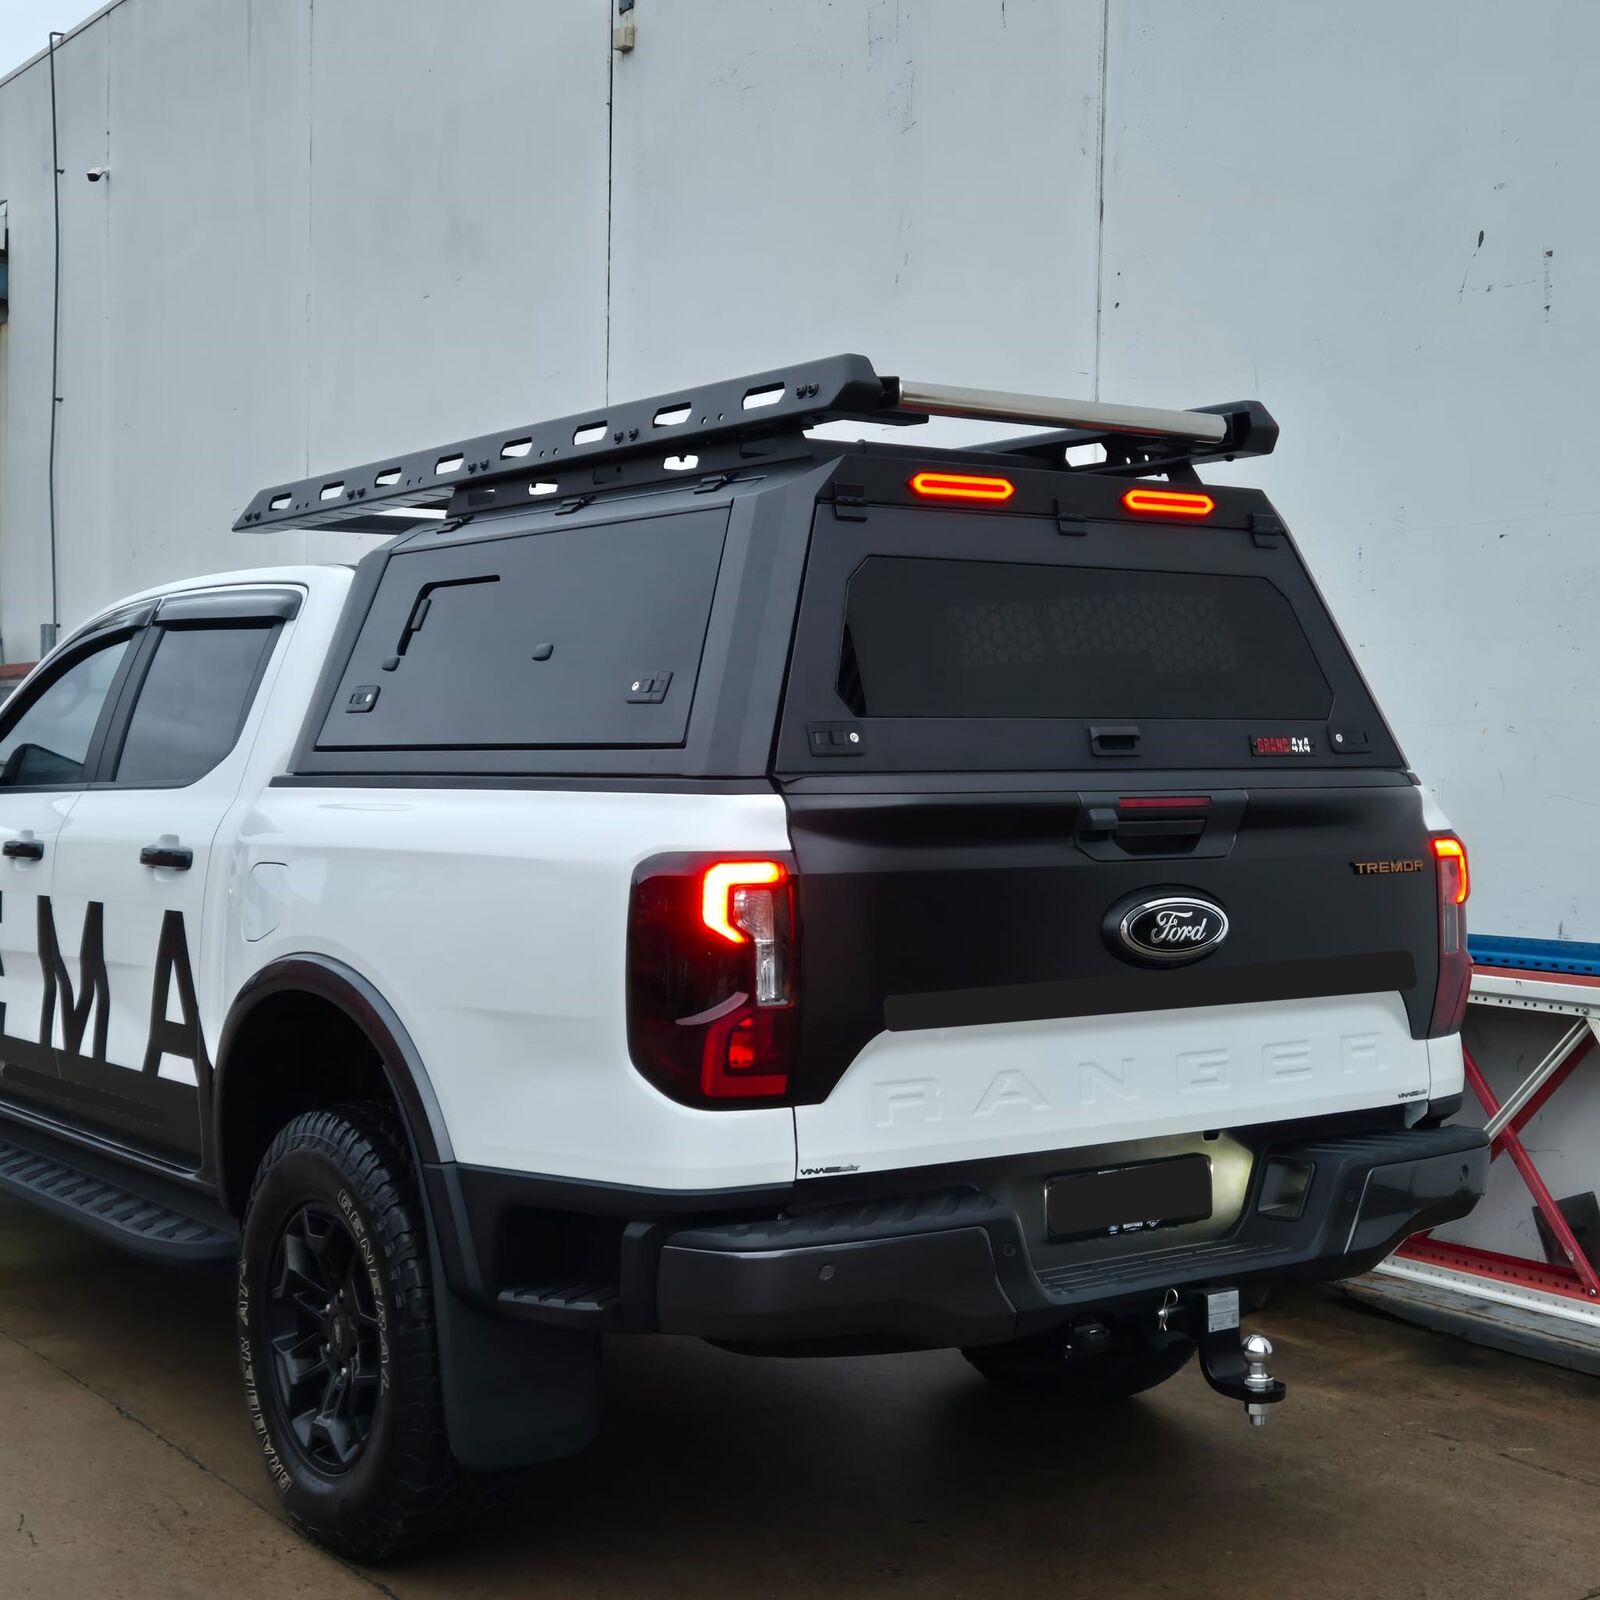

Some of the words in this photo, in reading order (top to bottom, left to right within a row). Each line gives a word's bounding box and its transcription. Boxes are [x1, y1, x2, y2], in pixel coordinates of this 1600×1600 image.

[1355, 860, 1424, 874] TREMOR
[1151, 911, 1207, 943] Ford
[0, 890, 213, 1087] MA
[873, 1031, 1389, 1128] RANGER
